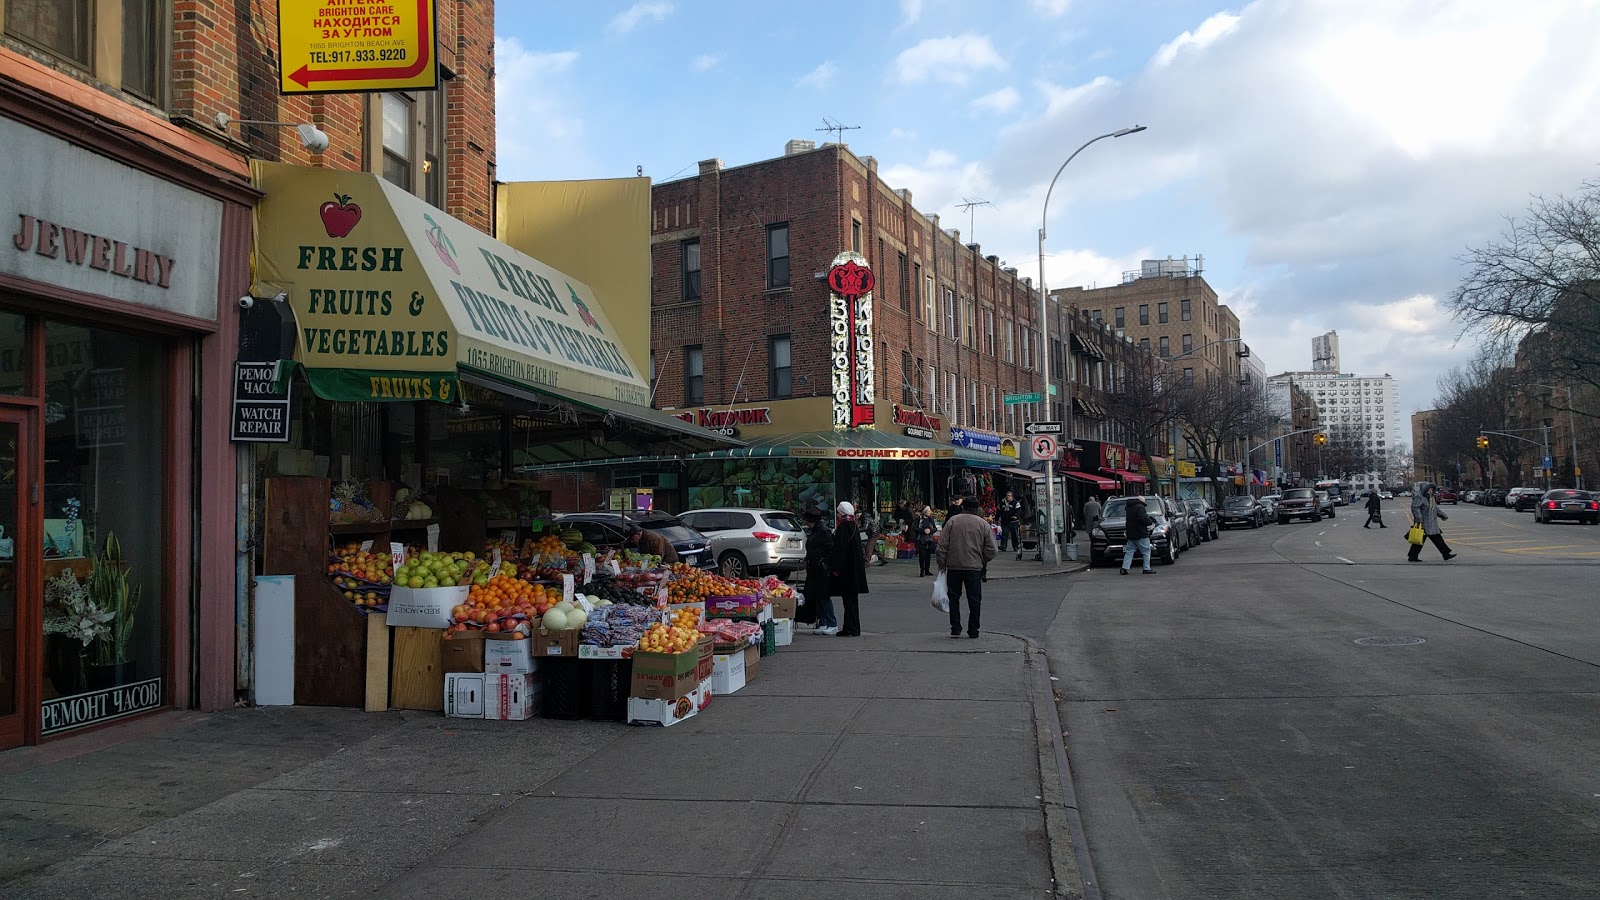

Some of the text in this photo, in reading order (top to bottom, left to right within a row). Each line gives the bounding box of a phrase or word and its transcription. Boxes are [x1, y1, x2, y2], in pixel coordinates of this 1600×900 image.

[313, 15, 400, 28] НАХОДИТСЯ
[319, 5, 394, 17] BRIGHTON CARE
[322, 27, 392, 39] ЗА УГЛОМ
[310, 48, 406, 63] TEL:917.933.9220
[13, 213, 177, 289] JEWELRY
[297, 245, 404, 272] FRESH
[478, 247, 569, 316] FRESH
[308, 288, 425, 316] FRUITS &
[450, 279, 538, 351] FRUITS
[536, 315, 635, 379] VEGETABLES
[303, 327, 448, 357] VEGETABLES
[467, 347, 558, 388] 1055 BRIGHTON BEACH AVE
[369, 376, 450, 400] FRUITS &
[240, 407, 281, 421] WATCH
[239, 421, 282, 434] REPAIR
[836, 449, 898, 458] GOURMET
[901, 449, 930, 458] FOOD
[636, 672, 664, 681] APPLES
[41, 681, 159, 731] РЕМОНТ ЧАСОВ
